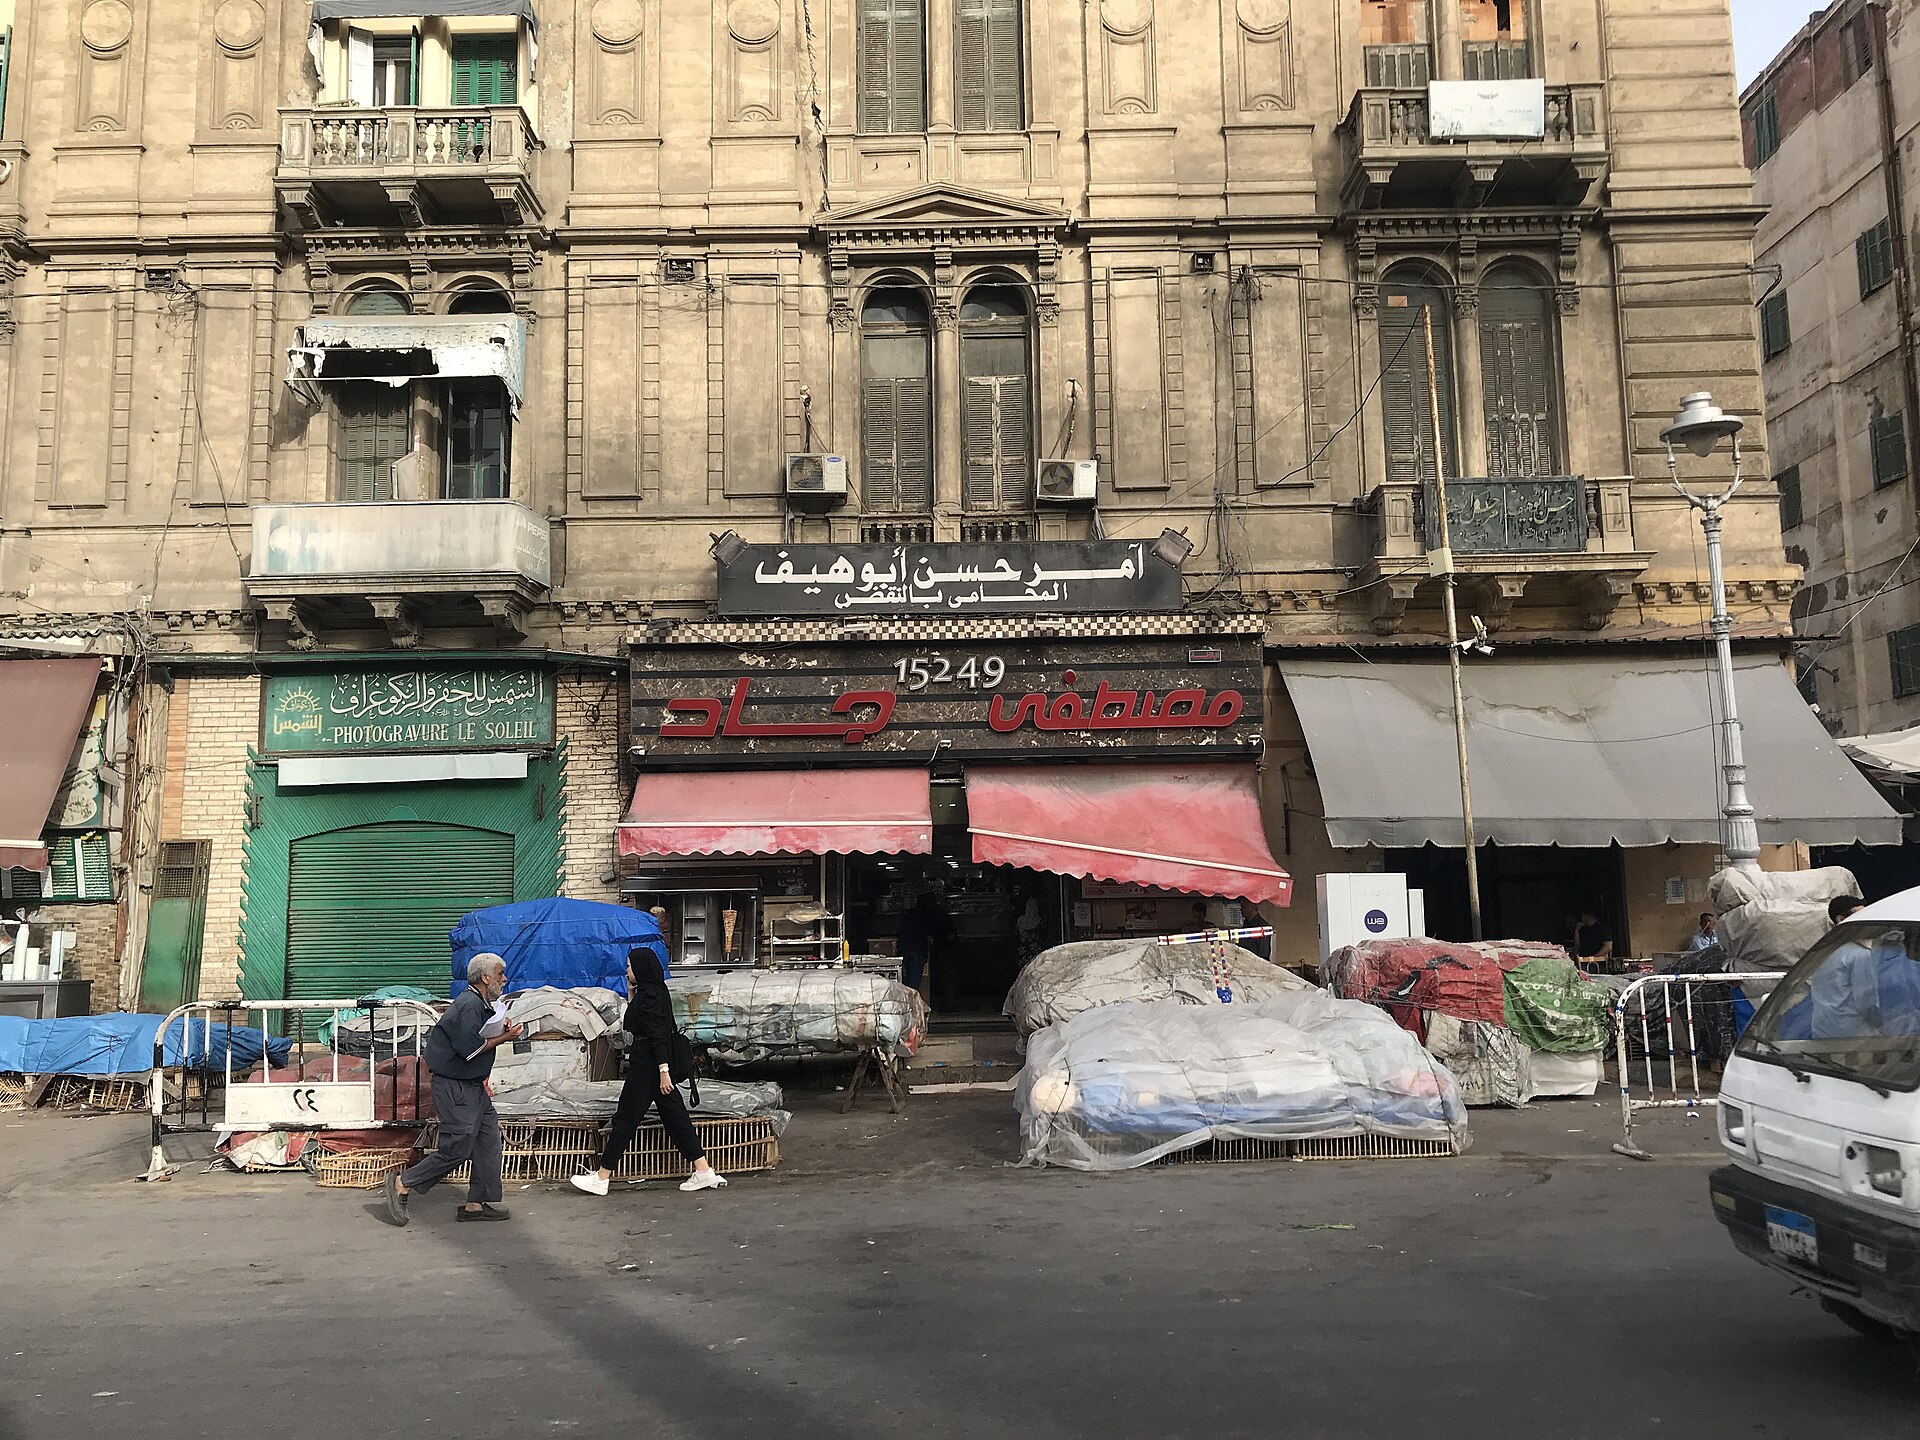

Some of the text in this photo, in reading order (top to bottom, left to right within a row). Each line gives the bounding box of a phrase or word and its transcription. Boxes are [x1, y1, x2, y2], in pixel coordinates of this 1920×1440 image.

[913, 556, 1022, 589] حسن
[834, 584, 943, 609] بالنقض
[893, 656, 1005, 691] 15249
[465, 671, 542, 716] الشمس
[658, 668, 1244, 744] مصطفى جاد
[274, 713, 323, 735] الشمس
[333, 720, 538, 744] PHOTOGRAVURE LE SOLEIL
